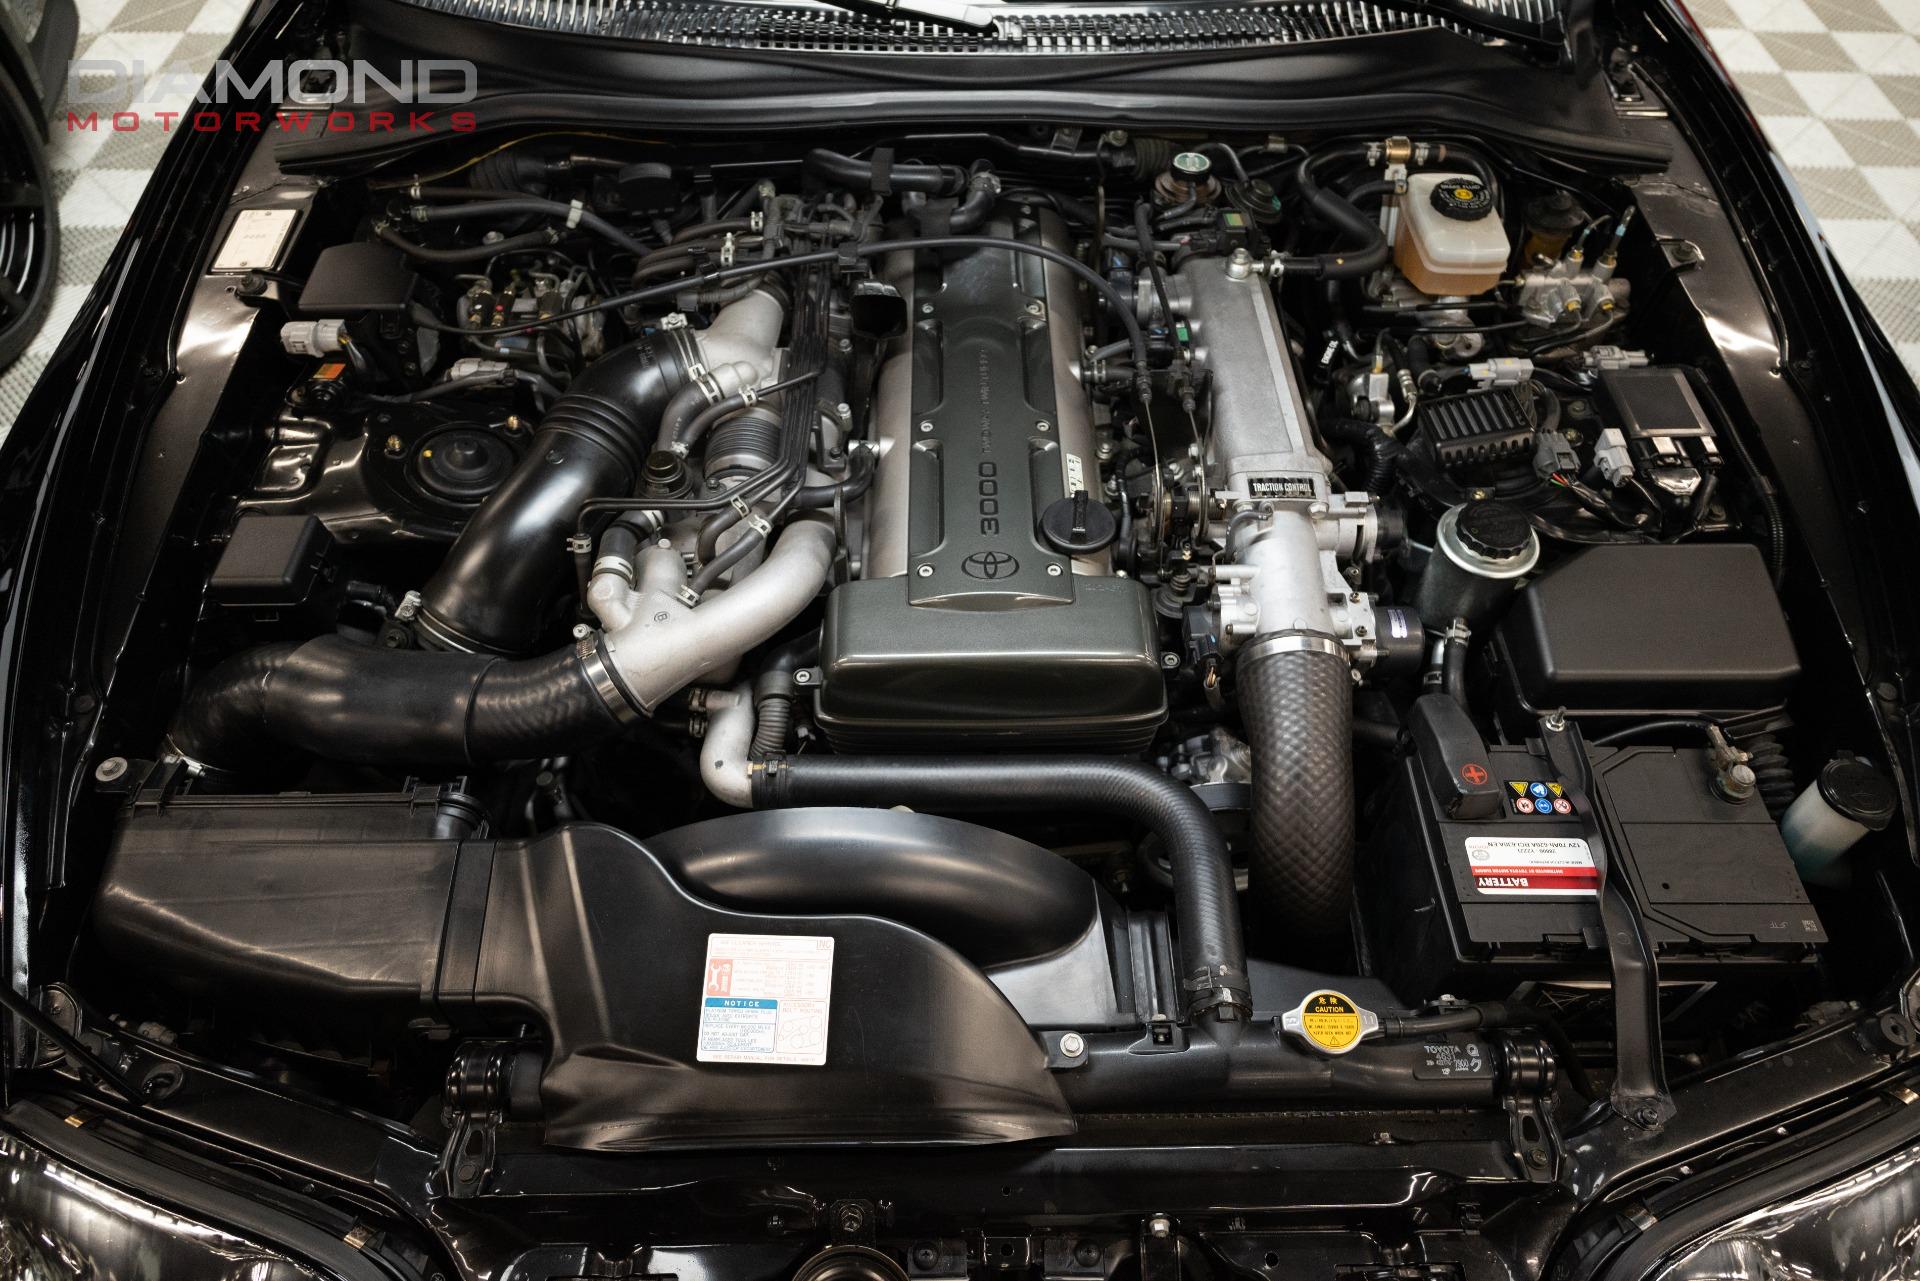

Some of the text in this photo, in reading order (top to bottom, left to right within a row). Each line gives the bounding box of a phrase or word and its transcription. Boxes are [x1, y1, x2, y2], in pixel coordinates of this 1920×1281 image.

[1253, 482, 1312, 492] TRACTION CONTROL
[979, 461, 1000, 536] 3000
[1478, 877, 1529, 887] BATTERY
